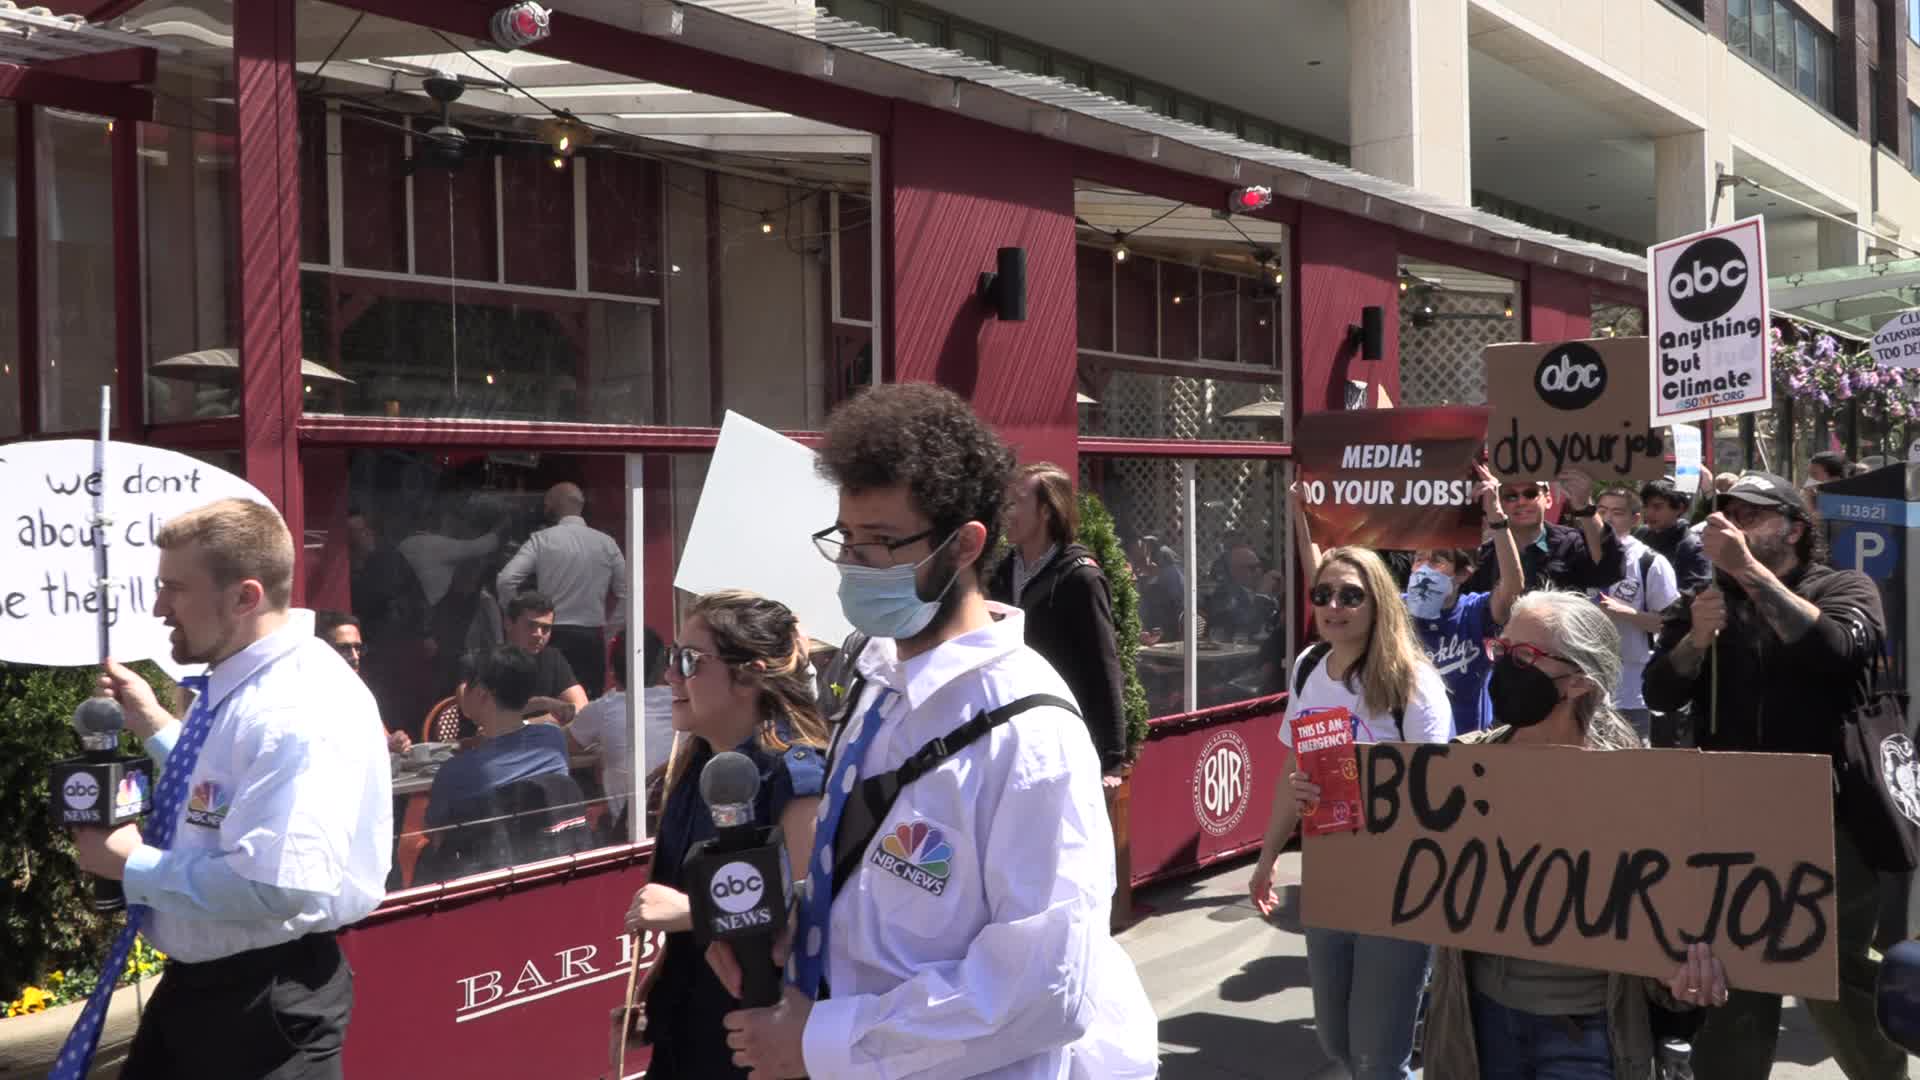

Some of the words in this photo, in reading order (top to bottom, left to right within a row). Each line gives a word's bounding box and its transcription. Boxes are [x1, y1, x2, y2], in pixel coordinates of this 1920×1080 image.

[1669, 259, 1748, 300] abc
[1875, 346, 1900, 360] TOO
[1541, 354, 1601, 392] abc
[1341, 443, 1423, 469] MEDIA:
[1494, 417, 1543, 475] do
[1546, 431, 1619, 477] your
[1614, 420, 1664, 475] job
[46, 471, 103, 496] we
[123, 464, 201, 494] don't
[1332, 479, 1394, 505] YOUR
[1400, 479, 1473, 506] JOBS!
[1855, 531, 1886, 576] P
[1297, 724, 1316, 738] THIS
[1315, 721, 1326, 734] IS
[1328, 718, 1344, 732] AN
[1297, 731, 1347, 754] EMERGENCY
[64, 781, 97, 797] abc
[1204, 748, 1242, 816] BAR
[712, 875, 763, 899] abc
[872, 850, 905, 877] NBC
[903, 865, 944, 895] NEWS
[1391, 836, 1488, 933] DO
[1494, 836, 1689, 963] YOUR
[1678, 852, 1834, 963] JOB
[715, 908, 772, 933] NEWS
[456, 944, 600, 1012] BAR
